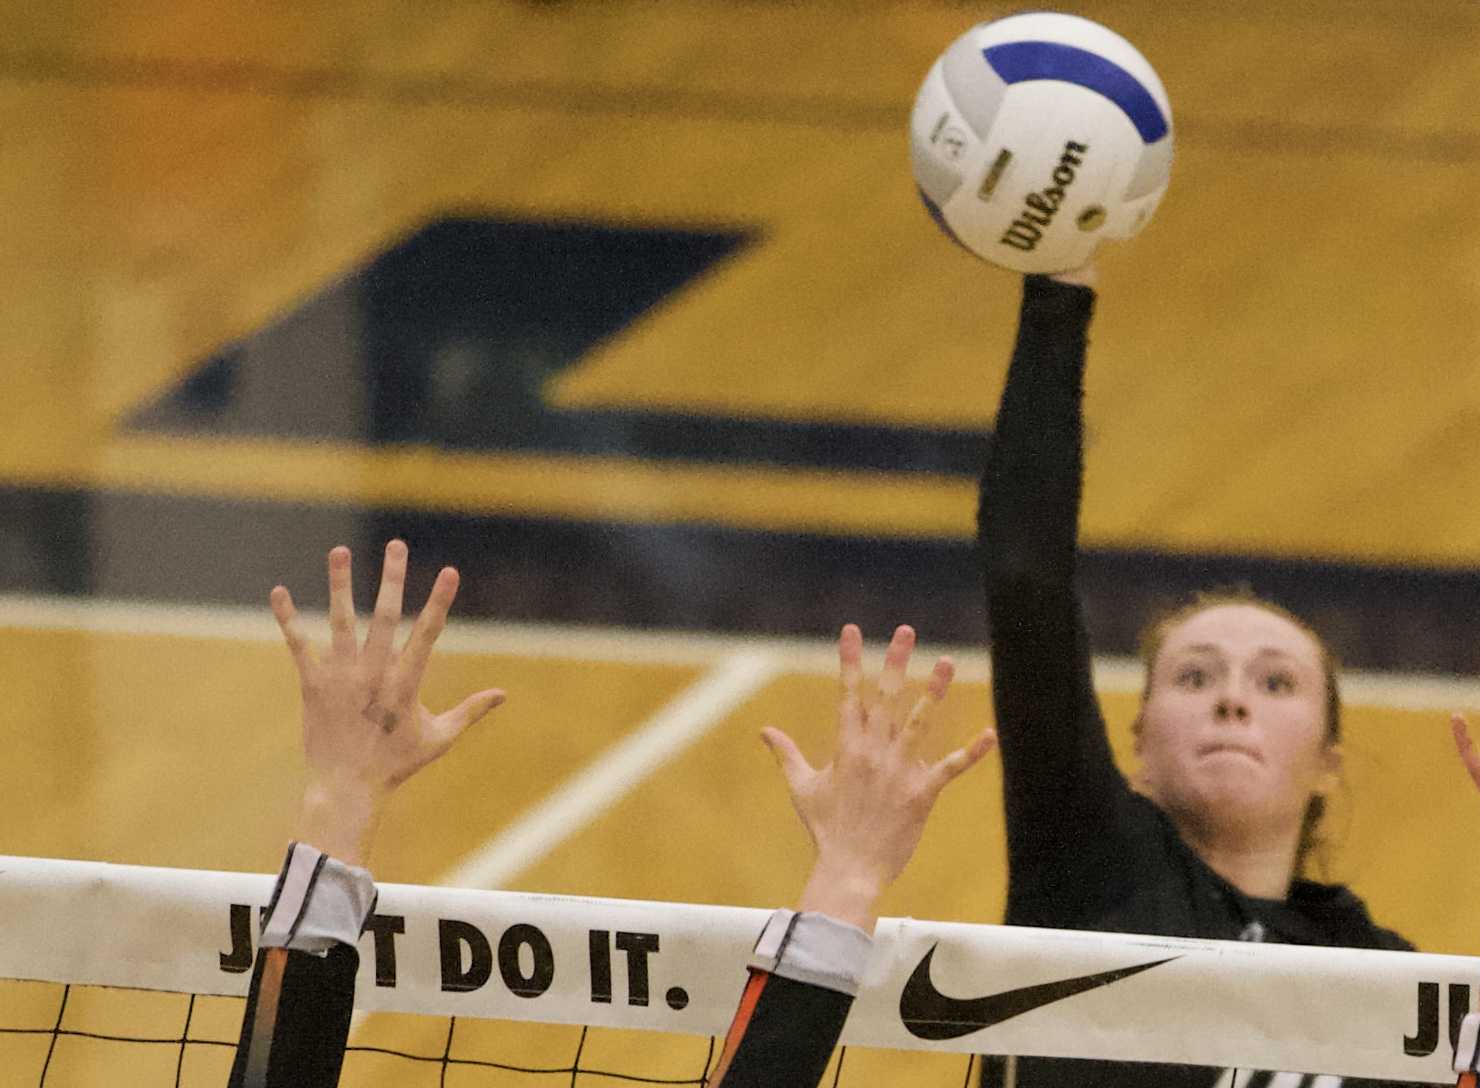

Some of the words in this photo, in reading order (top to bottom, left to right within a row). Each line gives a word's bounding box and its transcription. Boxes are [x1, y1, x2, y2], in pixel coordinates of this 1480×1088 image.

[999, 140, 1089, 251] Wilson
[219, 904, 405, 988] JT
[438, 919, 555, 999] DO
[589, 929, 689, 1010] IT.
